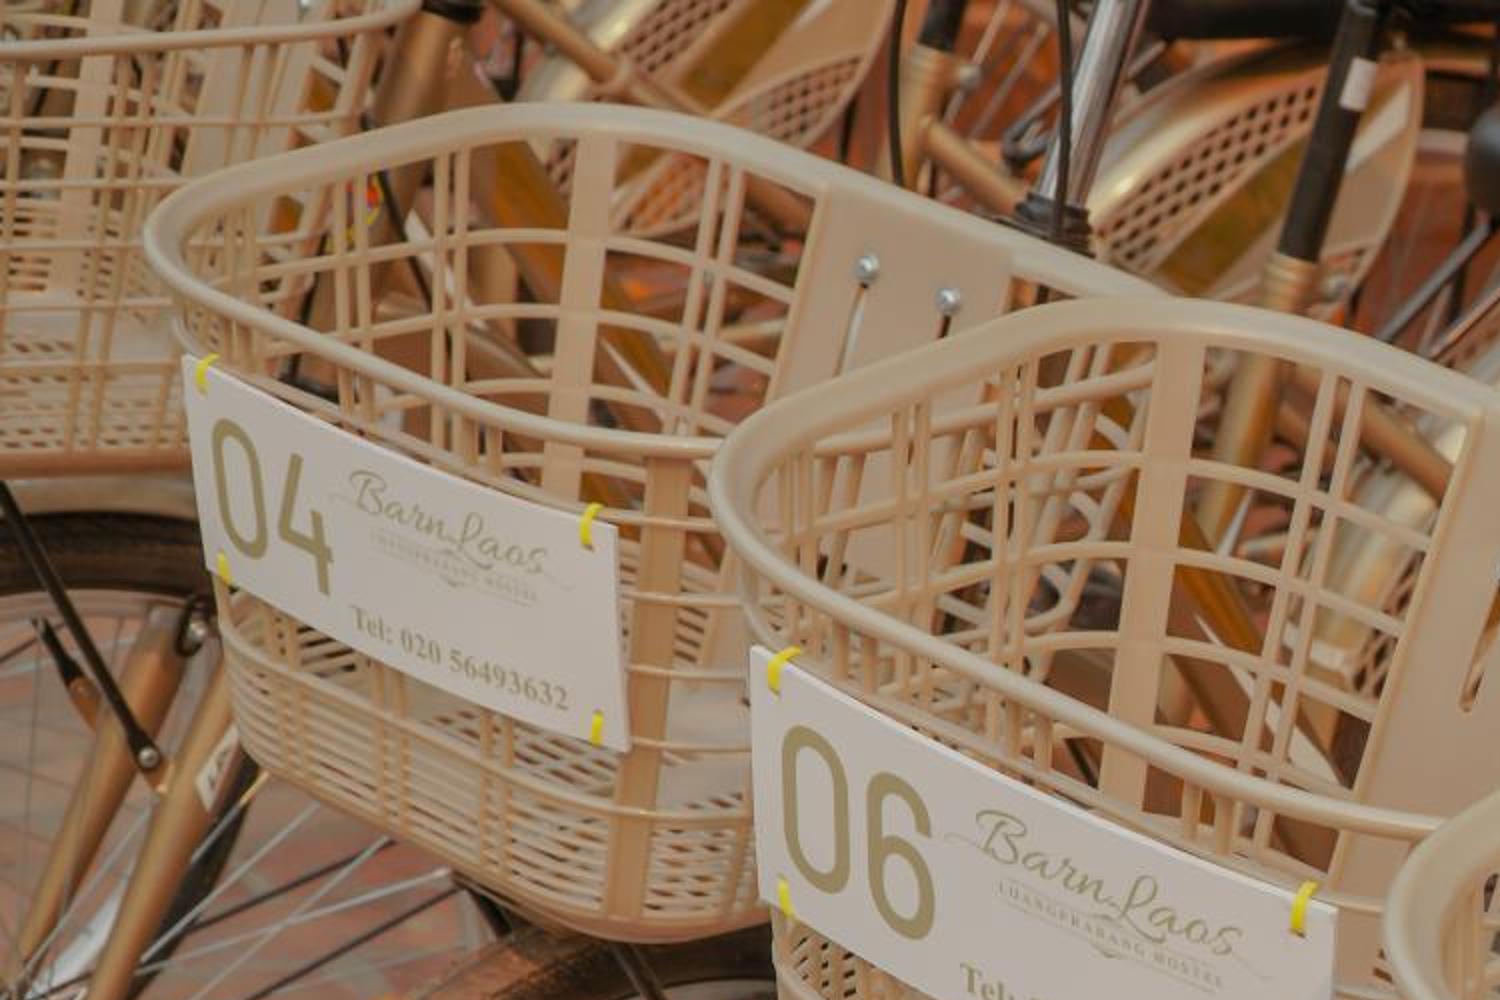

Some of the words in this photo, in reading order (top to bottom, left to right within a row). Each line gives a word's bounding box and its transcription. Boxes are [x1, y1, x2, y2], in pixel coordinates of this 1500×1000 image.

[211, 418, 334, 597] 04
[350, 604, 393, 645] Tel:
[400, 628, 442, 665] 020
[449, 648, 569, 711] 56493632
[781, 725, 935, 941] 06
